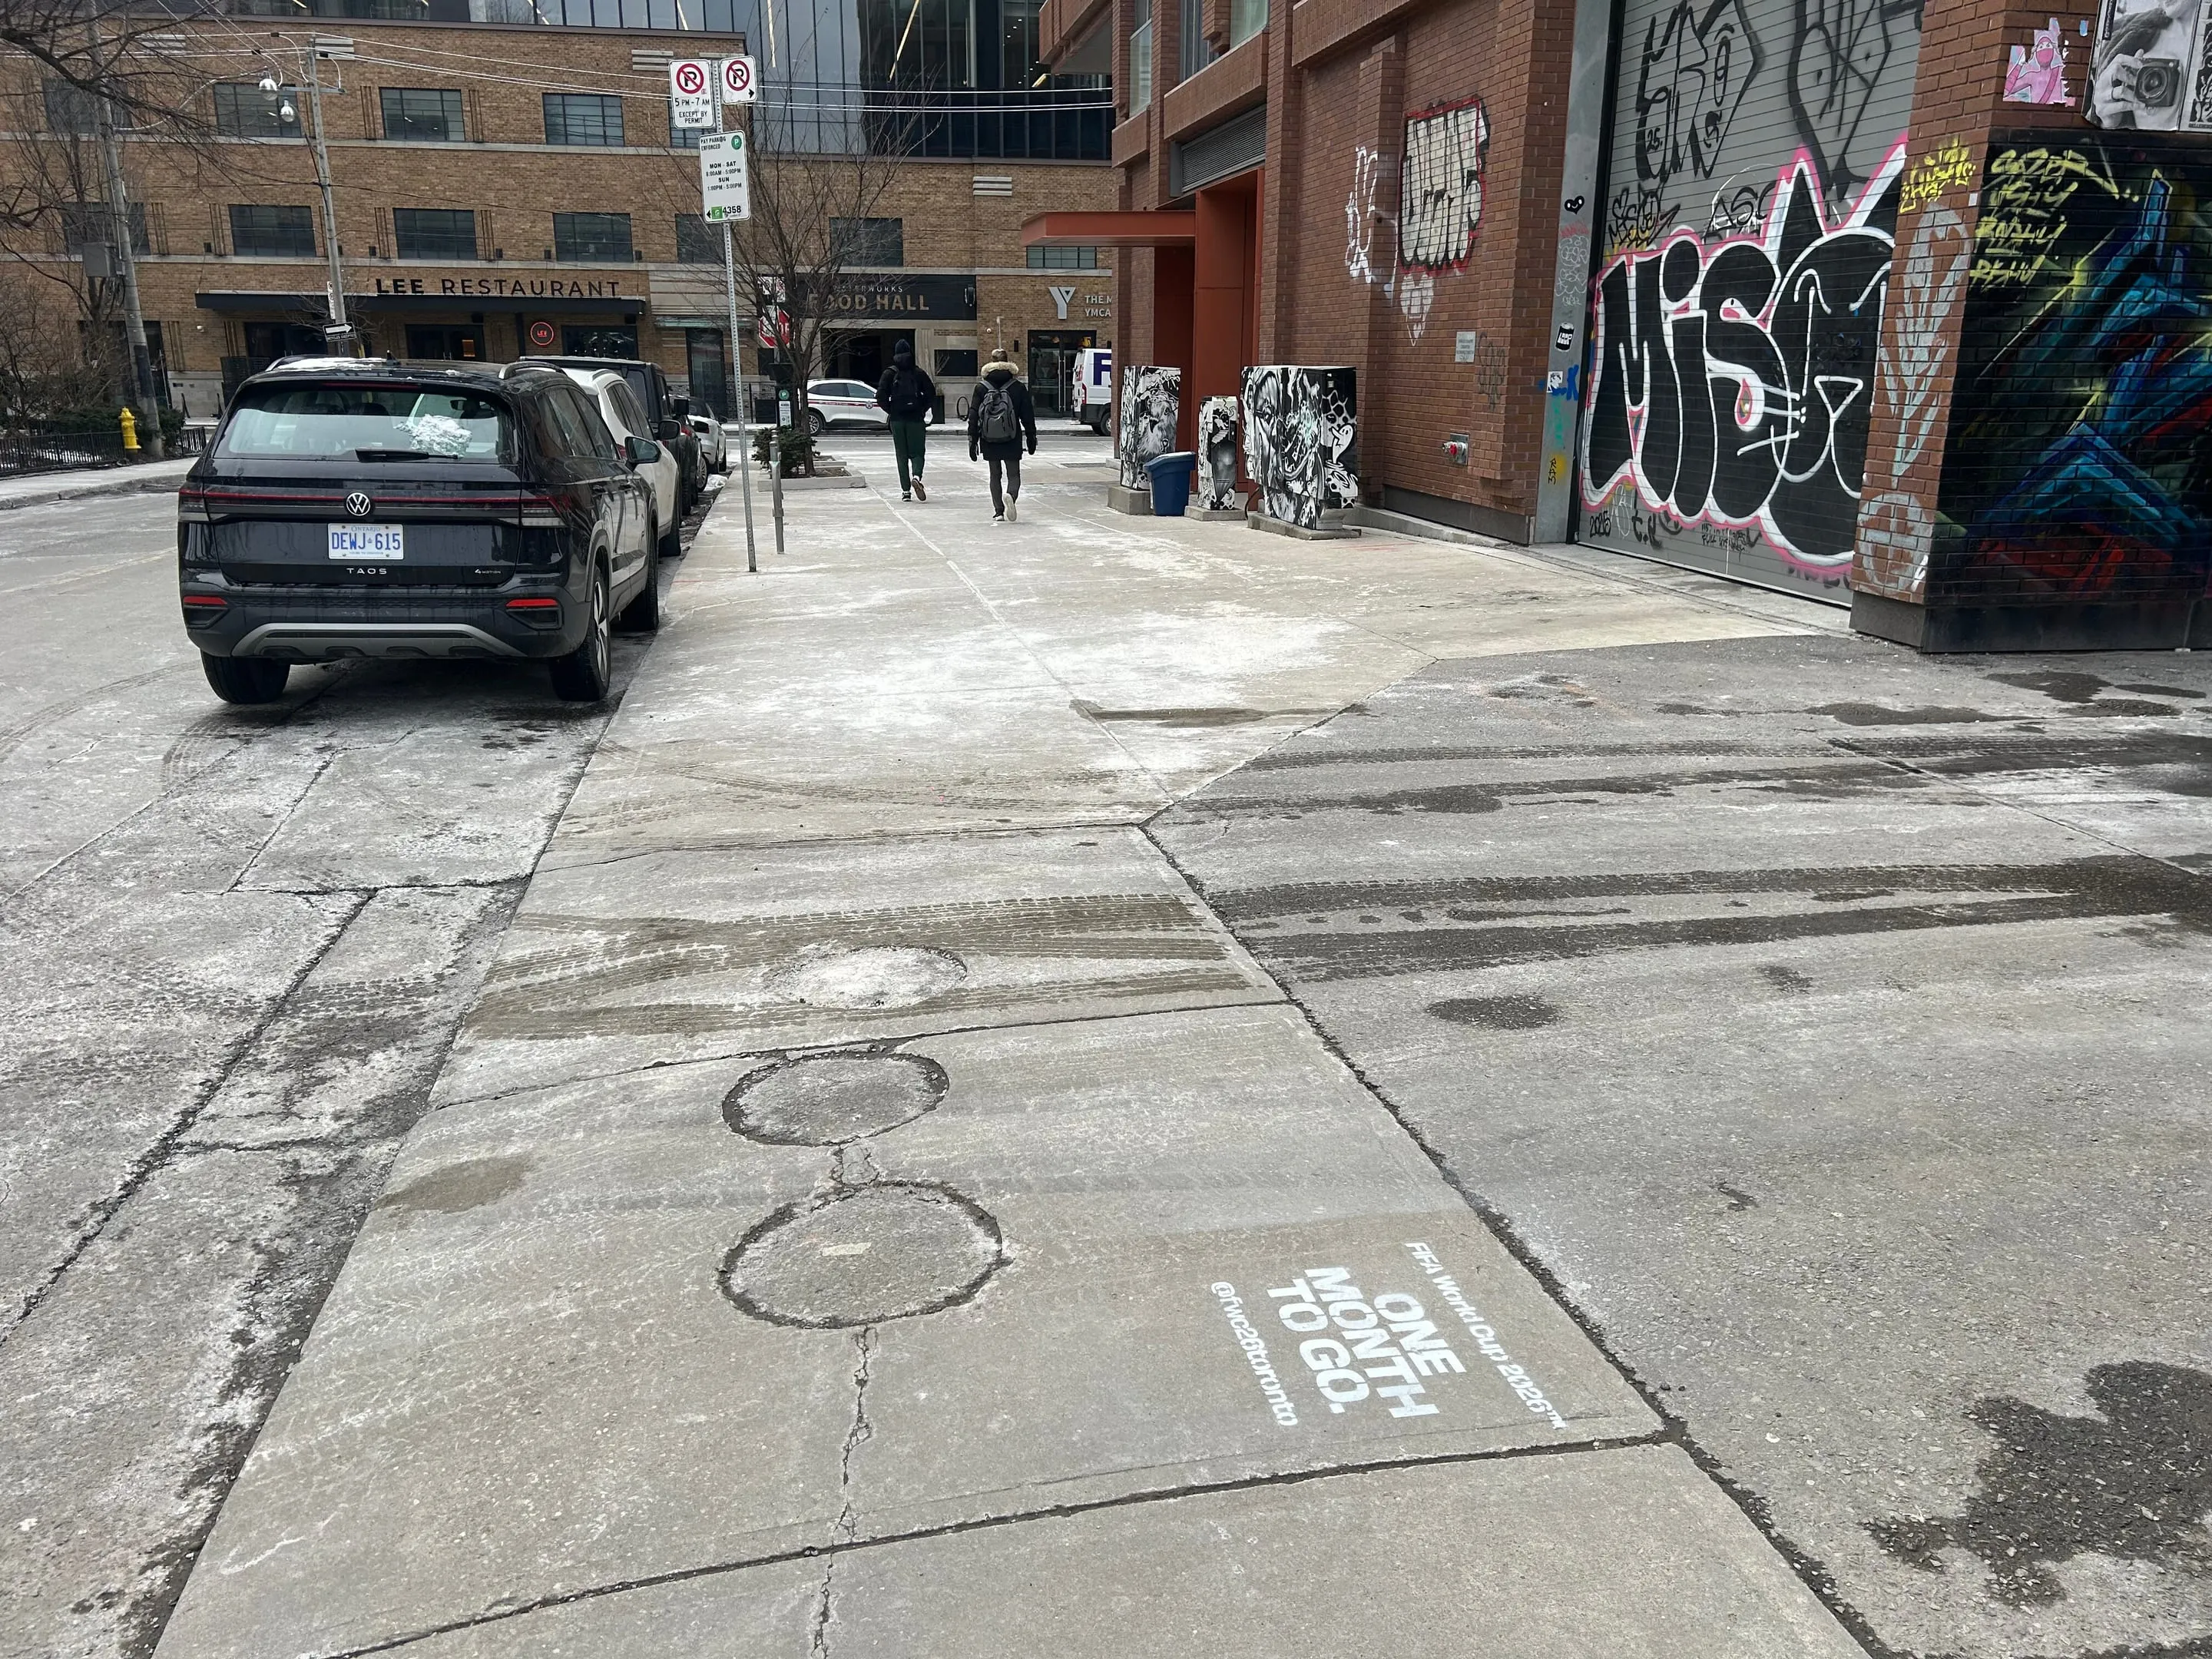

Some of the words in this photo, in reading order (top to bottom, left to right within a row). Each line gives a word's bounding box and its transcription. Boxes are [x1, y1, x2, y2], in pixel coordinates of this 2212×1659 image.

[675, 98, 680, 107] 5
[695, 98, 700, 106] 7
[722, 205, 741, 214] 4358
[375, 278, 425, 295] LEE
[441, 279, 620, 297] RESTAURANT
[876, 294, 929, 311] HALL
[1084, 295, 1104, 304] THE
[1084, 308, 1111, 317] YMCA
[1405, 1242, 1444, 1275] FIFA
[1432, 1275, 1485, 1323] World
[1469, 1324, 1508, 1363] Cup
[1304, 1267, 1441, 1419] MONTH
[1373, 1293, 1467, 1377] ONE
[1210, 1281, 1298, 1426] @fwc26toronto
[1267, 1278, 1329, 1333] TO
[1299, 1338, 1371, 1415] GO.
